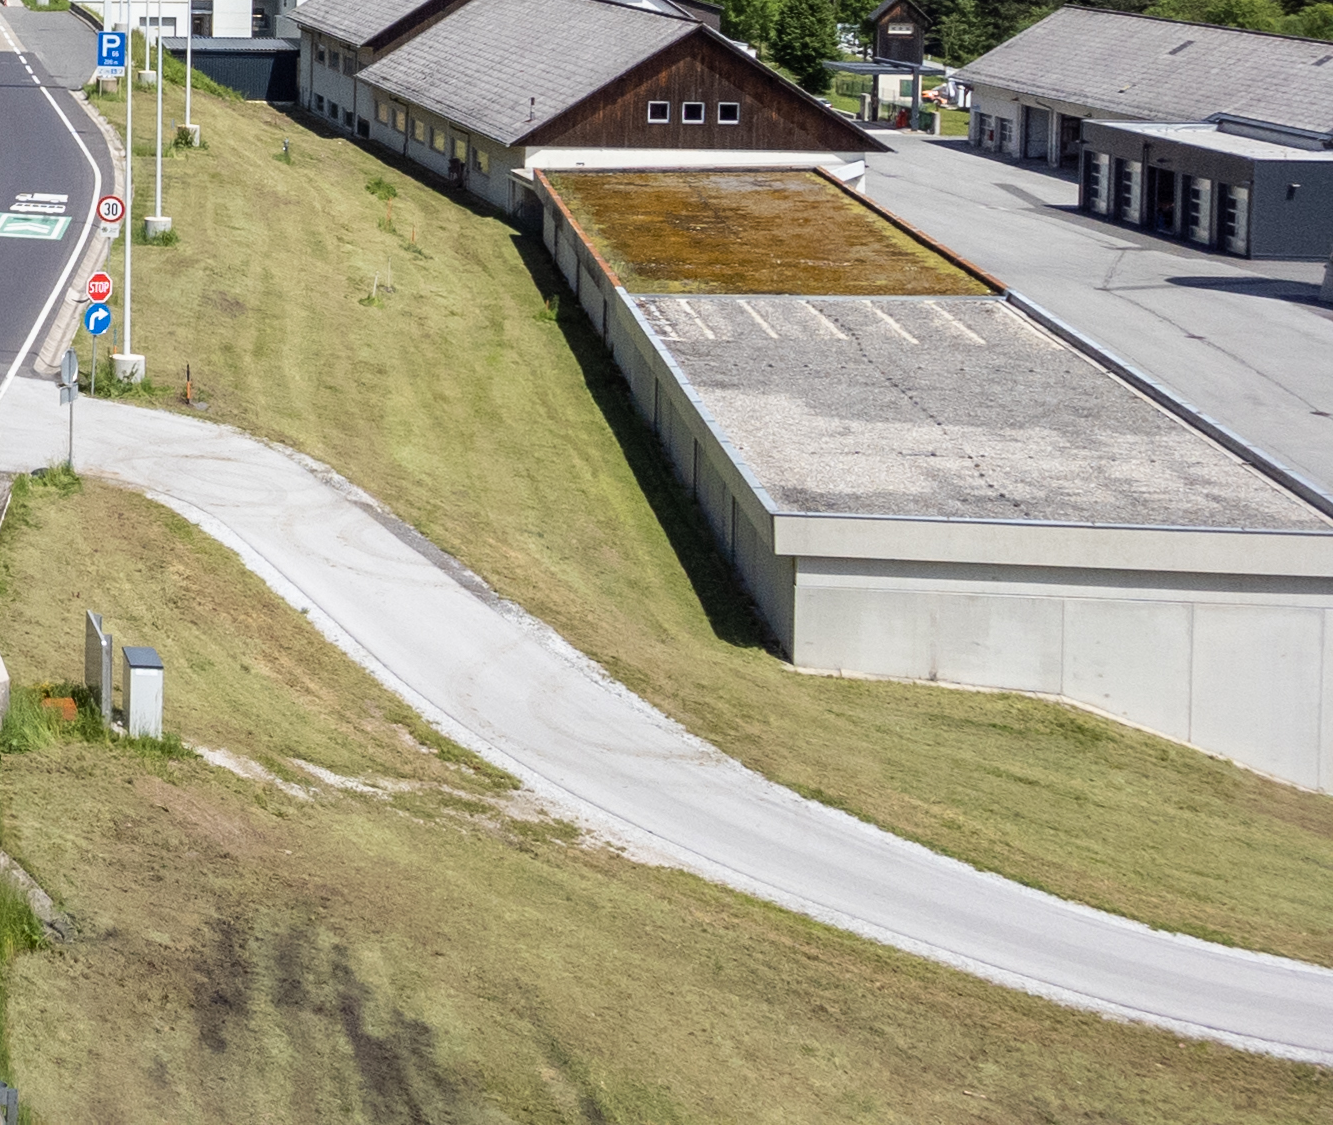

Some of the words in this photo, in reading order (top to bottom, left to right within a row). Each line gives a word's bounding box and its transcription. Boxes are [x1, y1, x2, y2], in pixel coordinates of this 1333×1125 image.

[102, 34, 121, 57] P
[104, 202, 118, 216] 30
[90, 282, 109, 293] STOP
